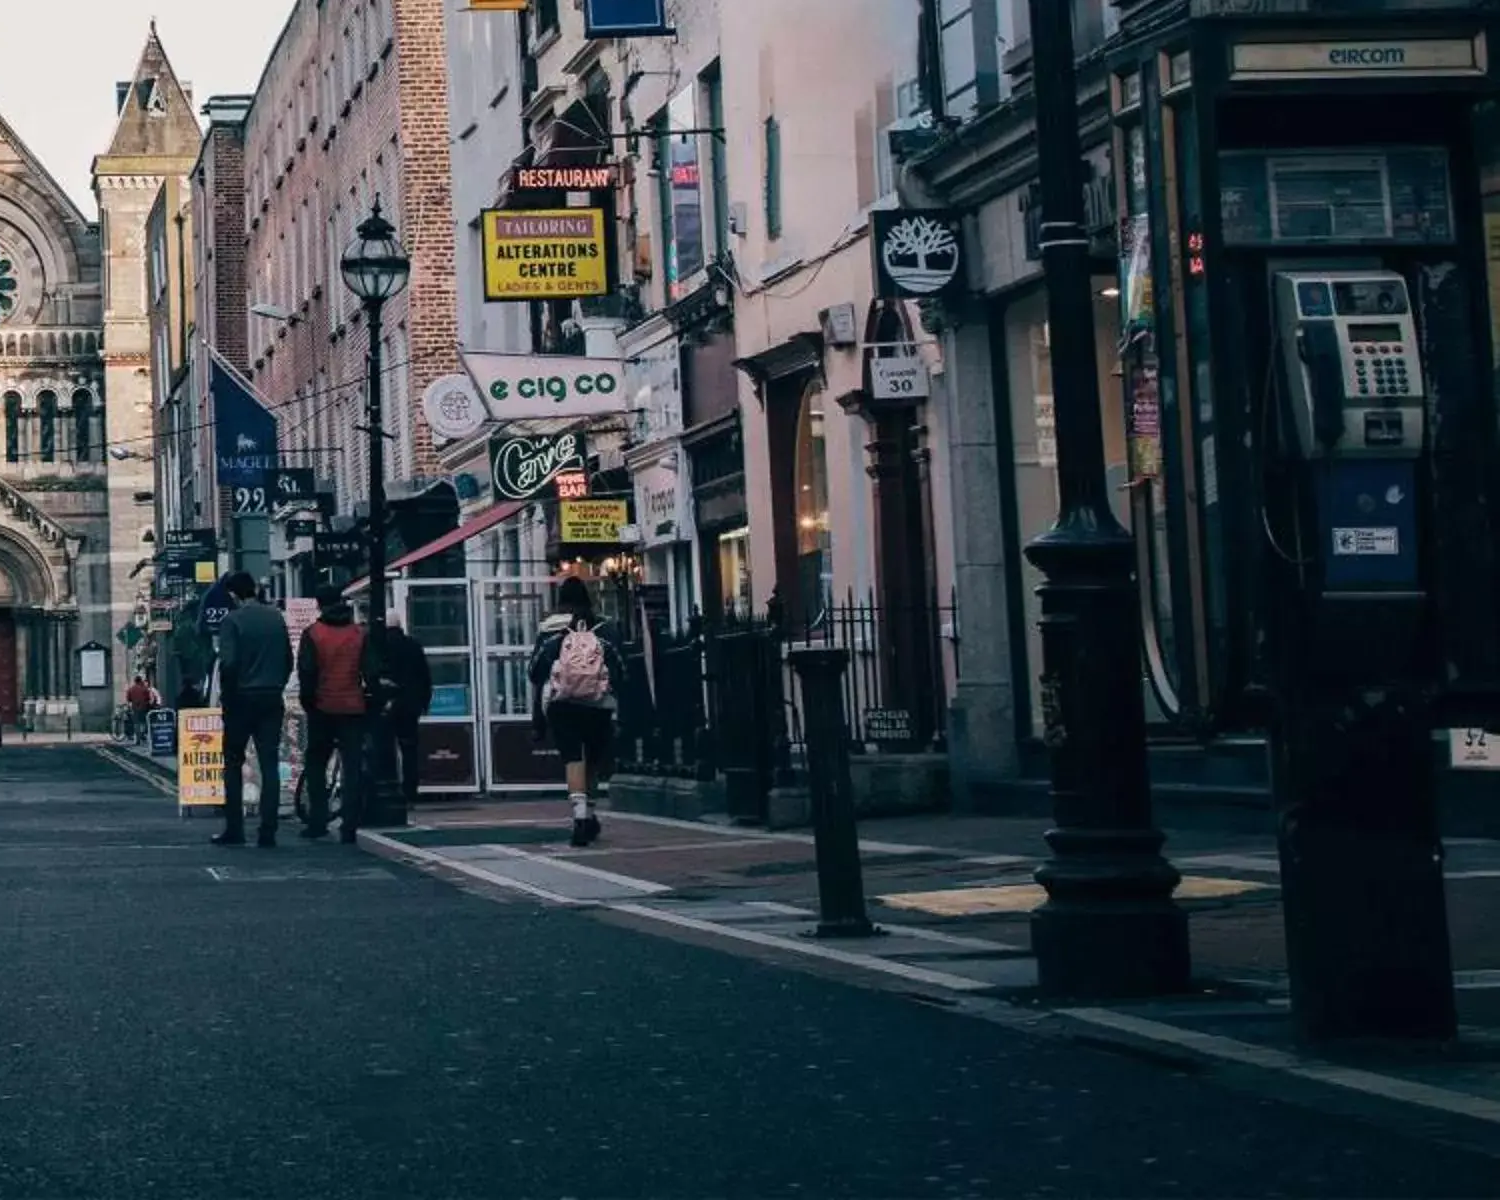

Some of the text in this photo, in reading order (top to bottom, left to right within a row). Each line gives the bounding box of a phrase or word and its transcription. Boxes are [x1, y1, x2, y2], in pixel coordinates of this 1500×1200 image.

[519, 169, 611, 188] RESTAURANT
[503, 218, 589, 235] TAILORING
[497, 243, 599, 260] ALTERATIONS
[518, 262, 577, 278] CENTRE
[498, 281, 542, 293] LADIES
[558, 279, 599, 291] GENTS
[889, 379, 913, 393] 30
[558, 484, 587, 498] BAR
[183, 751, 224, 765] ALTERAT
